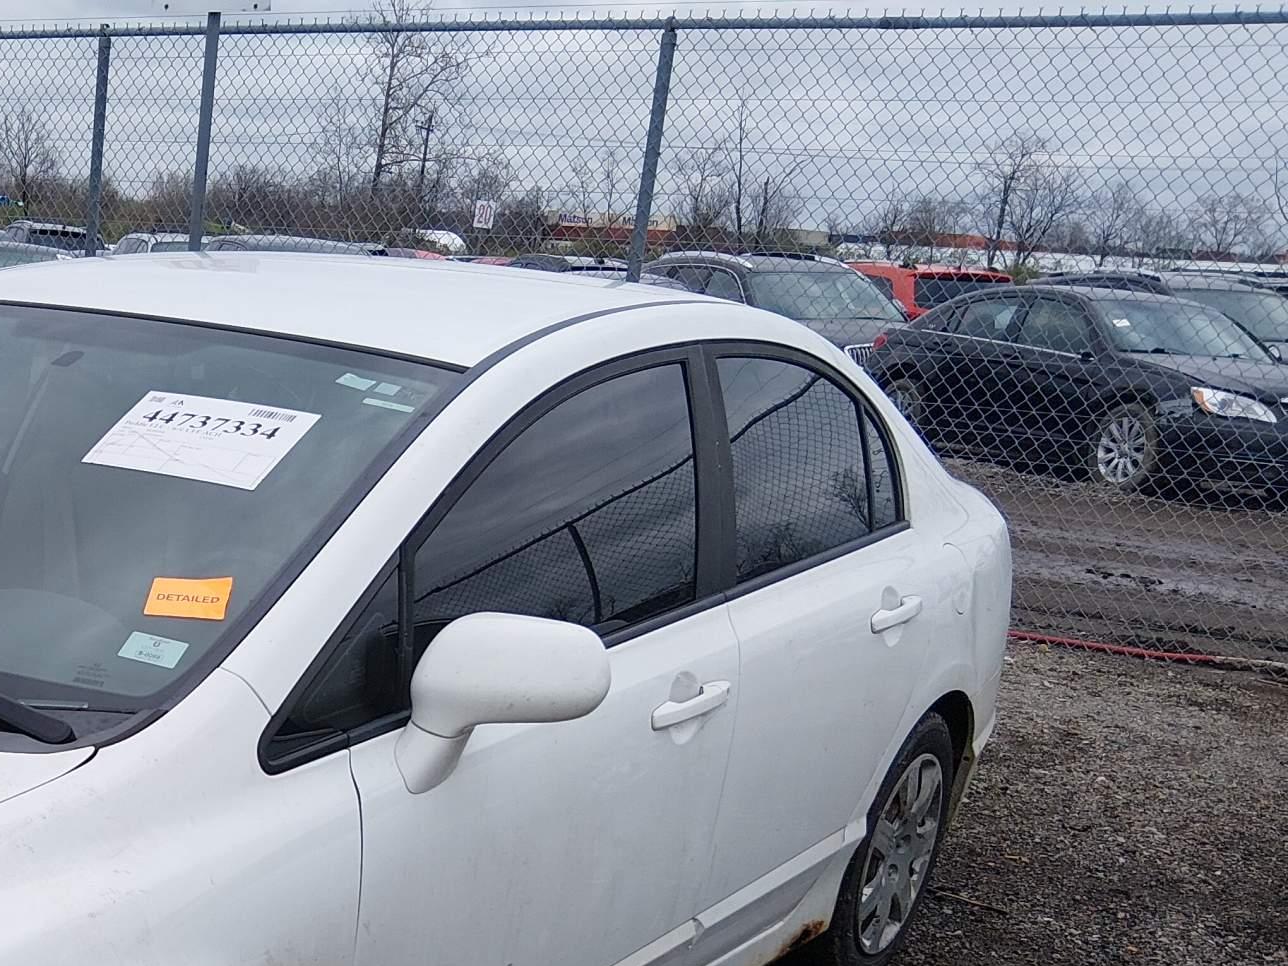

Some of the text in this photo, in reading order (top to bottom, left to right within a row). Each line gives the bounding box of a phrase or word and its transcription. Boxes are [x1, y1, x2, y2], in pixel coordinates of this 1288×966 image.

[476, 203, 492, 225] 20
[558, 212, 593, 224] Matson
[143, 409, 281, 440] 44737334
[156, 593, 221, 605] DETAILED
